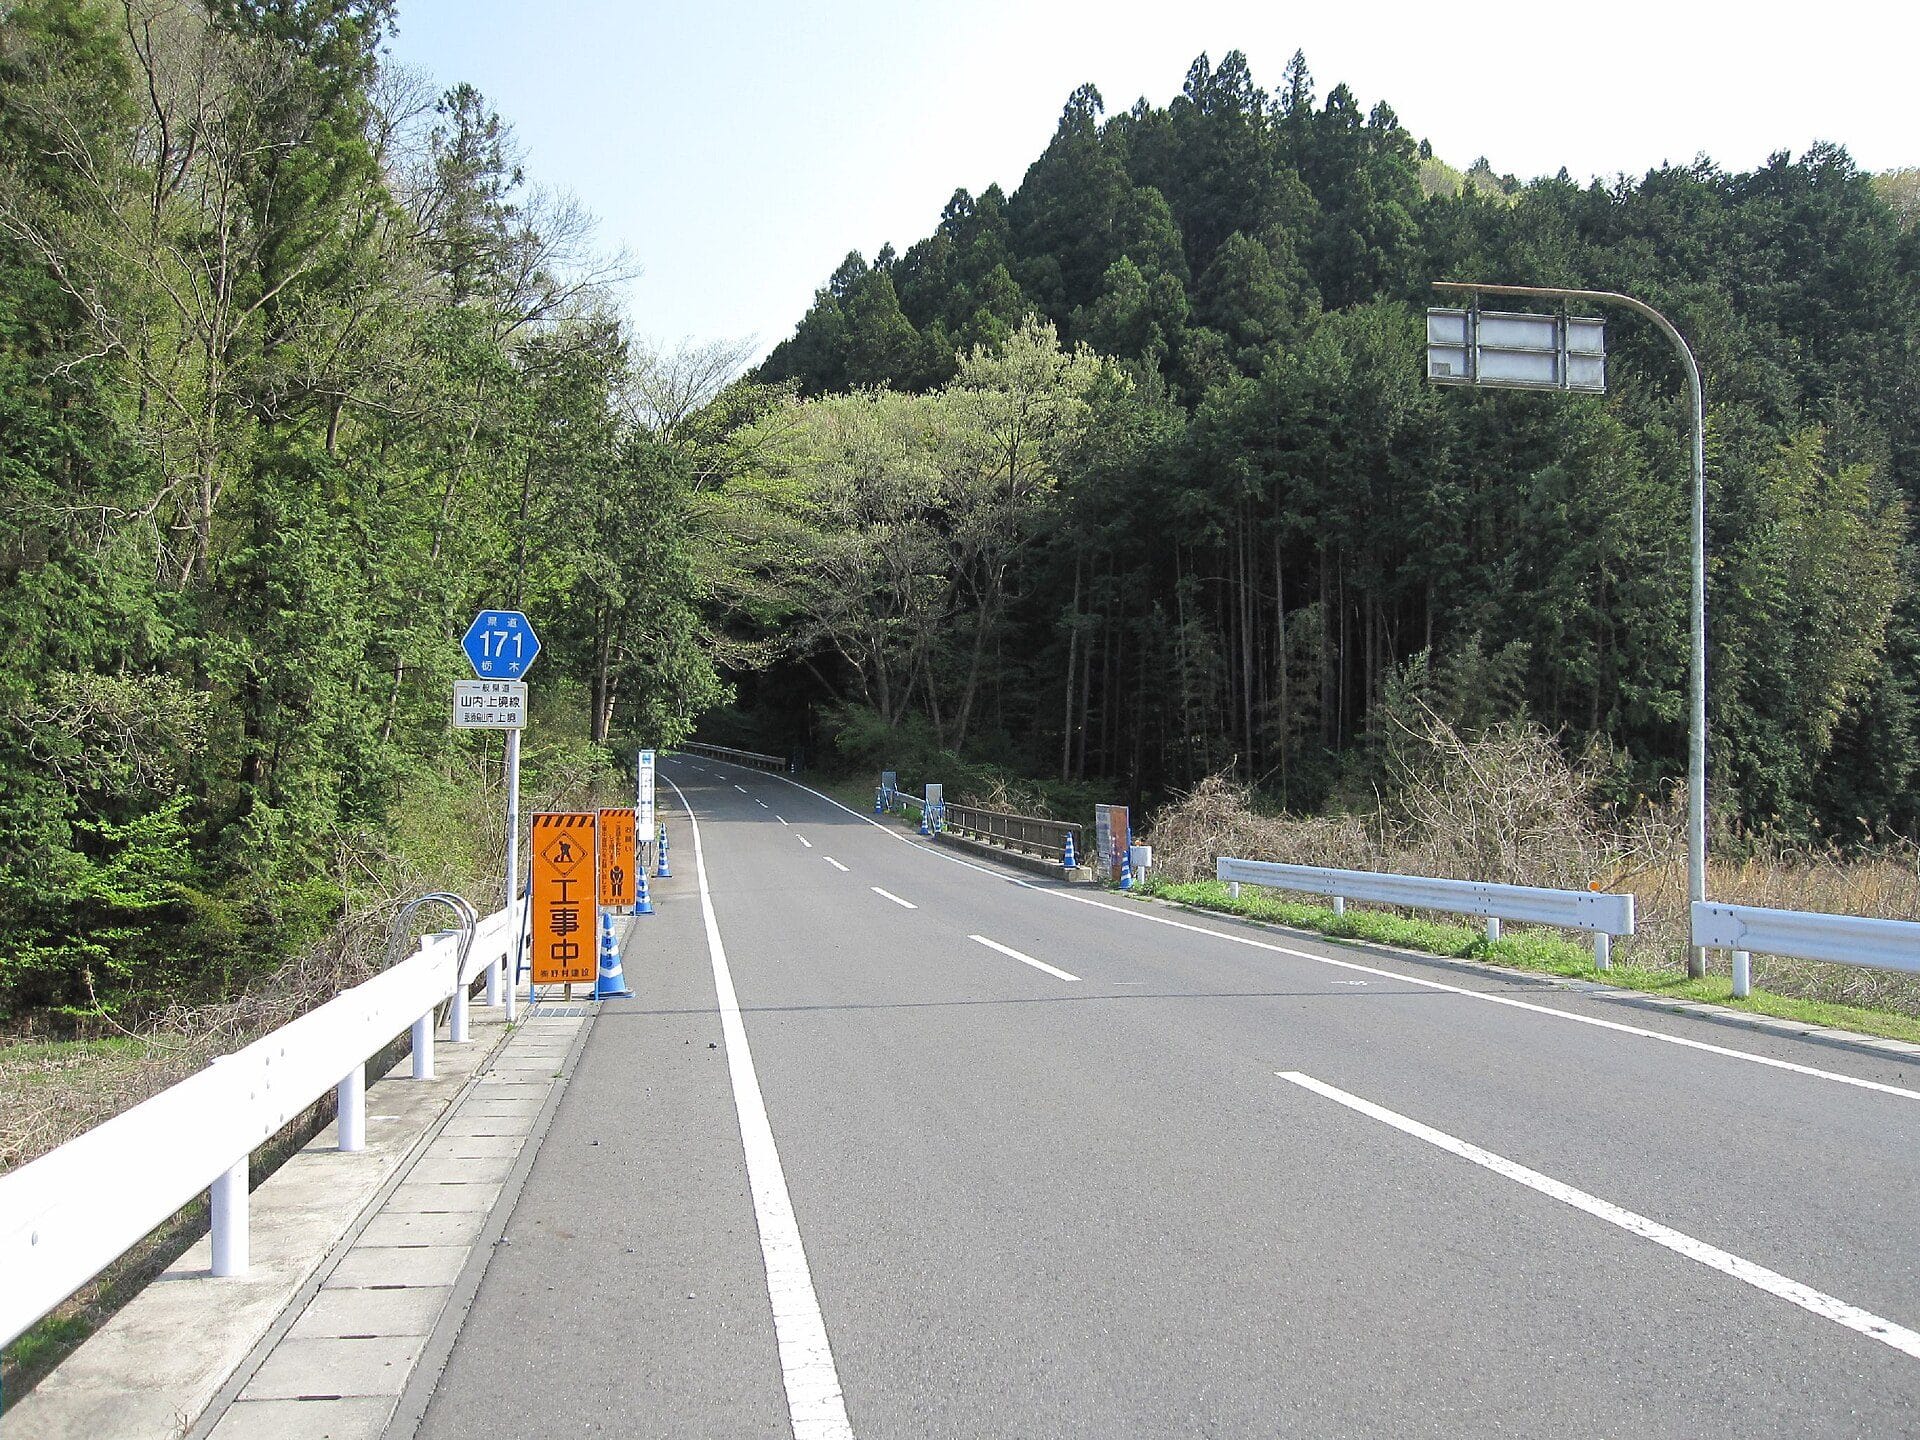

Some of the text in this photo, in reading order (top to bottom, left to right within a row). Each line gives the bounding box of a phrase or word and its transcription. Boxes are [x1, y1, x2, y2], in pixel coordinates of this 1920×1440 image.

[487, 617, 518, 628] 県道
[479, 630, 523, 659] 171
[481, 660, 521, 673] 栃木
[472, 683, 510, 693] 一般県道
[549, 879, 580, 968] 工事中
